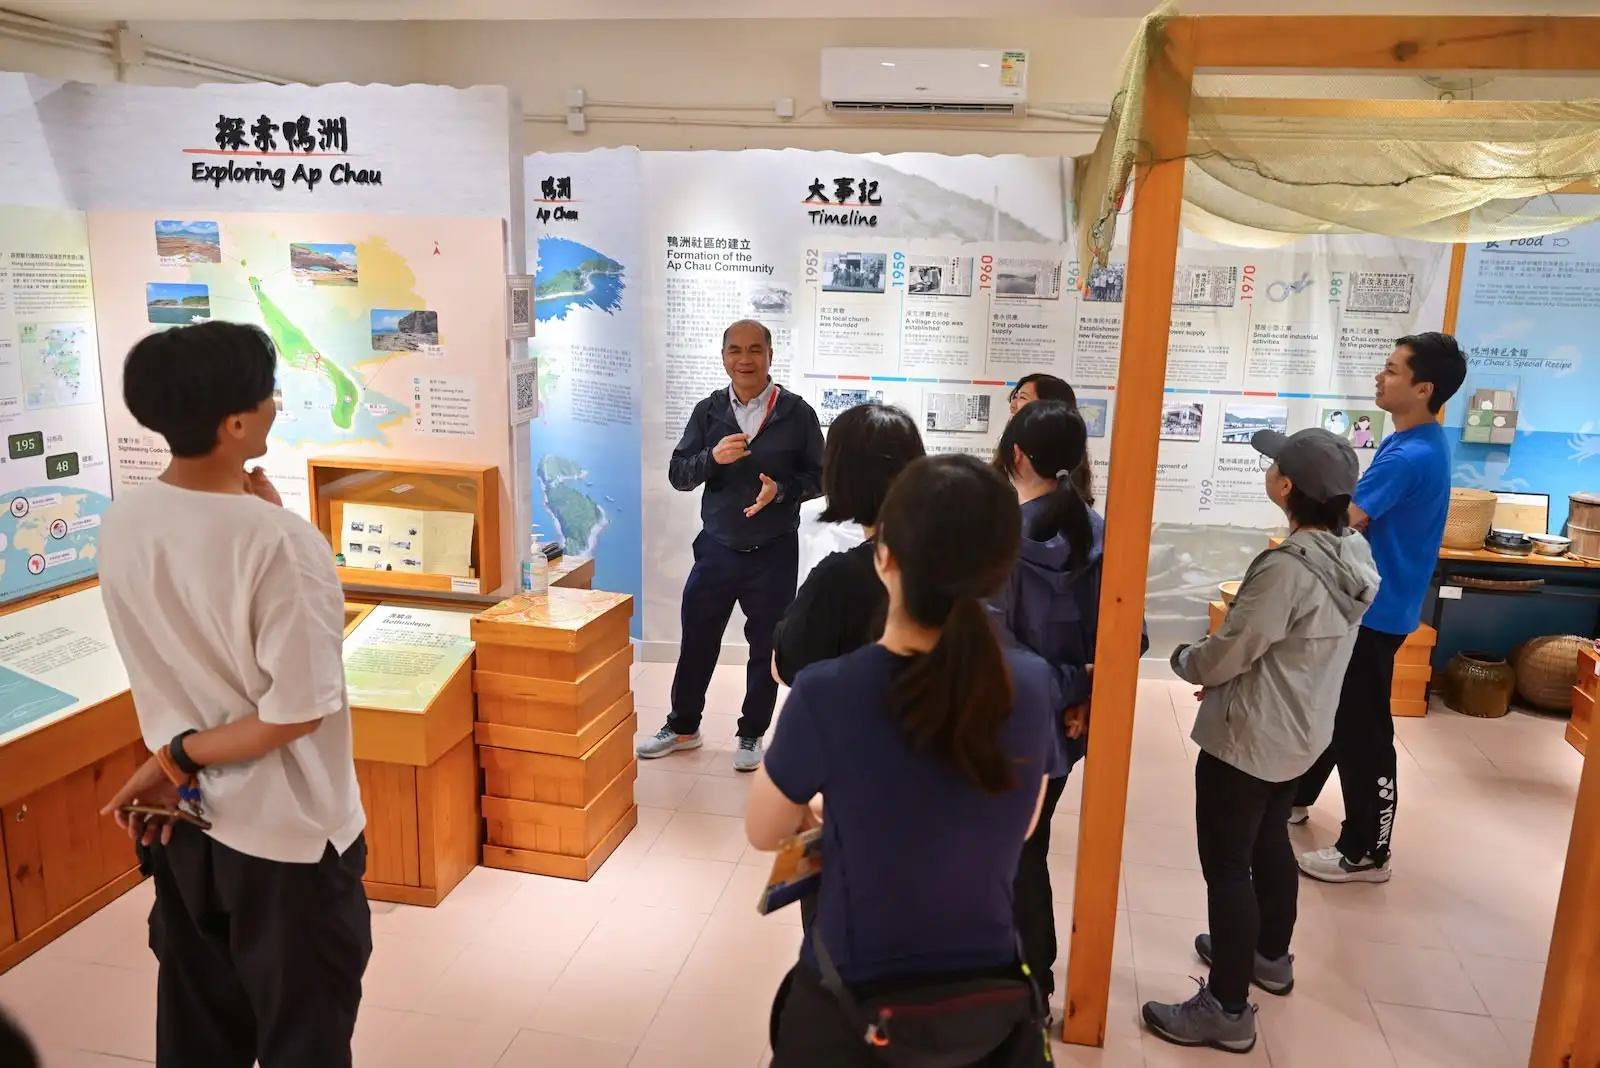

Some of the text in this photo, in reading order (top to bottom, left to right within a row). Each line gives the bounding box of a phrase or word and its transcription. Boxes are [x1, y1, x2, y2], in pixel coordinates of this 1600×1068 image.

[215, 114, 349, 153] 探索鴨洲
[191, 160, 383, 192] Exploring Ap Chau
[541, 176, 572, 200] 鴨洲
[805, 177, 882, 206] 大事記
[536, 206, 579, 224] Ap Chau
[808, 209, 878, 227] Timeline
[667, 236, 751, 250] 鴨洲社區的建立
[667, 250, 752, 262] Formation of the
[666, 261, 775, 275] Ap Chau Community
[806, 249, 819, 285] 1952
[892, 251, 905, 287] 1959
[979, 255, 993, 290] 1960
[1066, 259, 1081, 293] 1961
[1240, 265, 1256, 301] 1970
[1328, 271, 1345, 304] 1981
[905, 324, 941, 332] established
[911, 319, 932, 327] village
[1007, 322, 1030, 330] potable
[991, 328, 1013, 336] supply
[1253, 331, 1319, 341] Small-scale industrial
[1350, 335, 1367, 343] Chau
[1469, 358, 1572, 369] Ap Chau's Special Recipe
[16, 438, 36, 452] 195
[56, 459, 69, 472] 48
[1156, 463, 1179, 471] opment
[1217, 465, 1243, 474] Opening
[1198, 479, 1213, 512] 1969
[1376, 803, 1394, 850] YONEX
